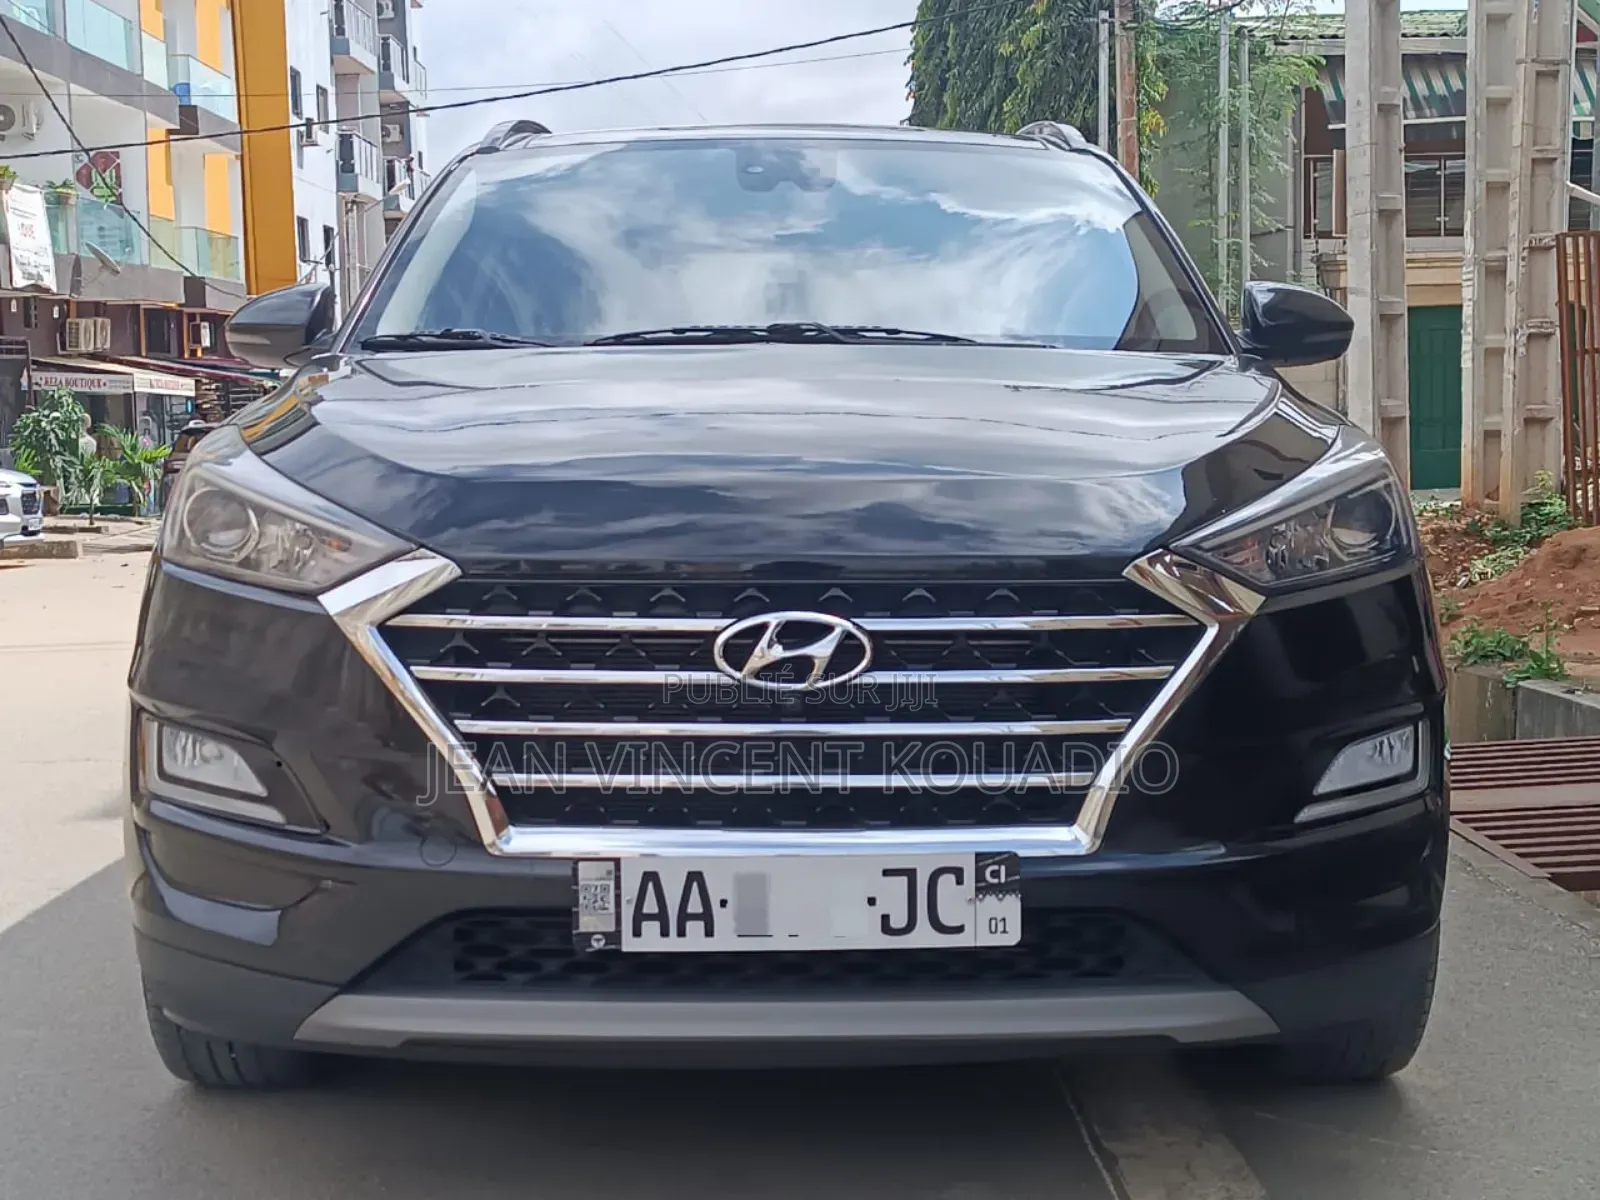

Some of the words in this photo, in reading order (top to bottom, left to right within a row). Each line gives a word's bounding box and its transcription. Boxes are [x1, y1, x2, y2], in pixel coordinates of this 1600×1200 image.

[64, 377, 102, 391] BOUTIQUE
[984, 864, 1006, 884] CI
[988, 916, 1009, 935] 01
